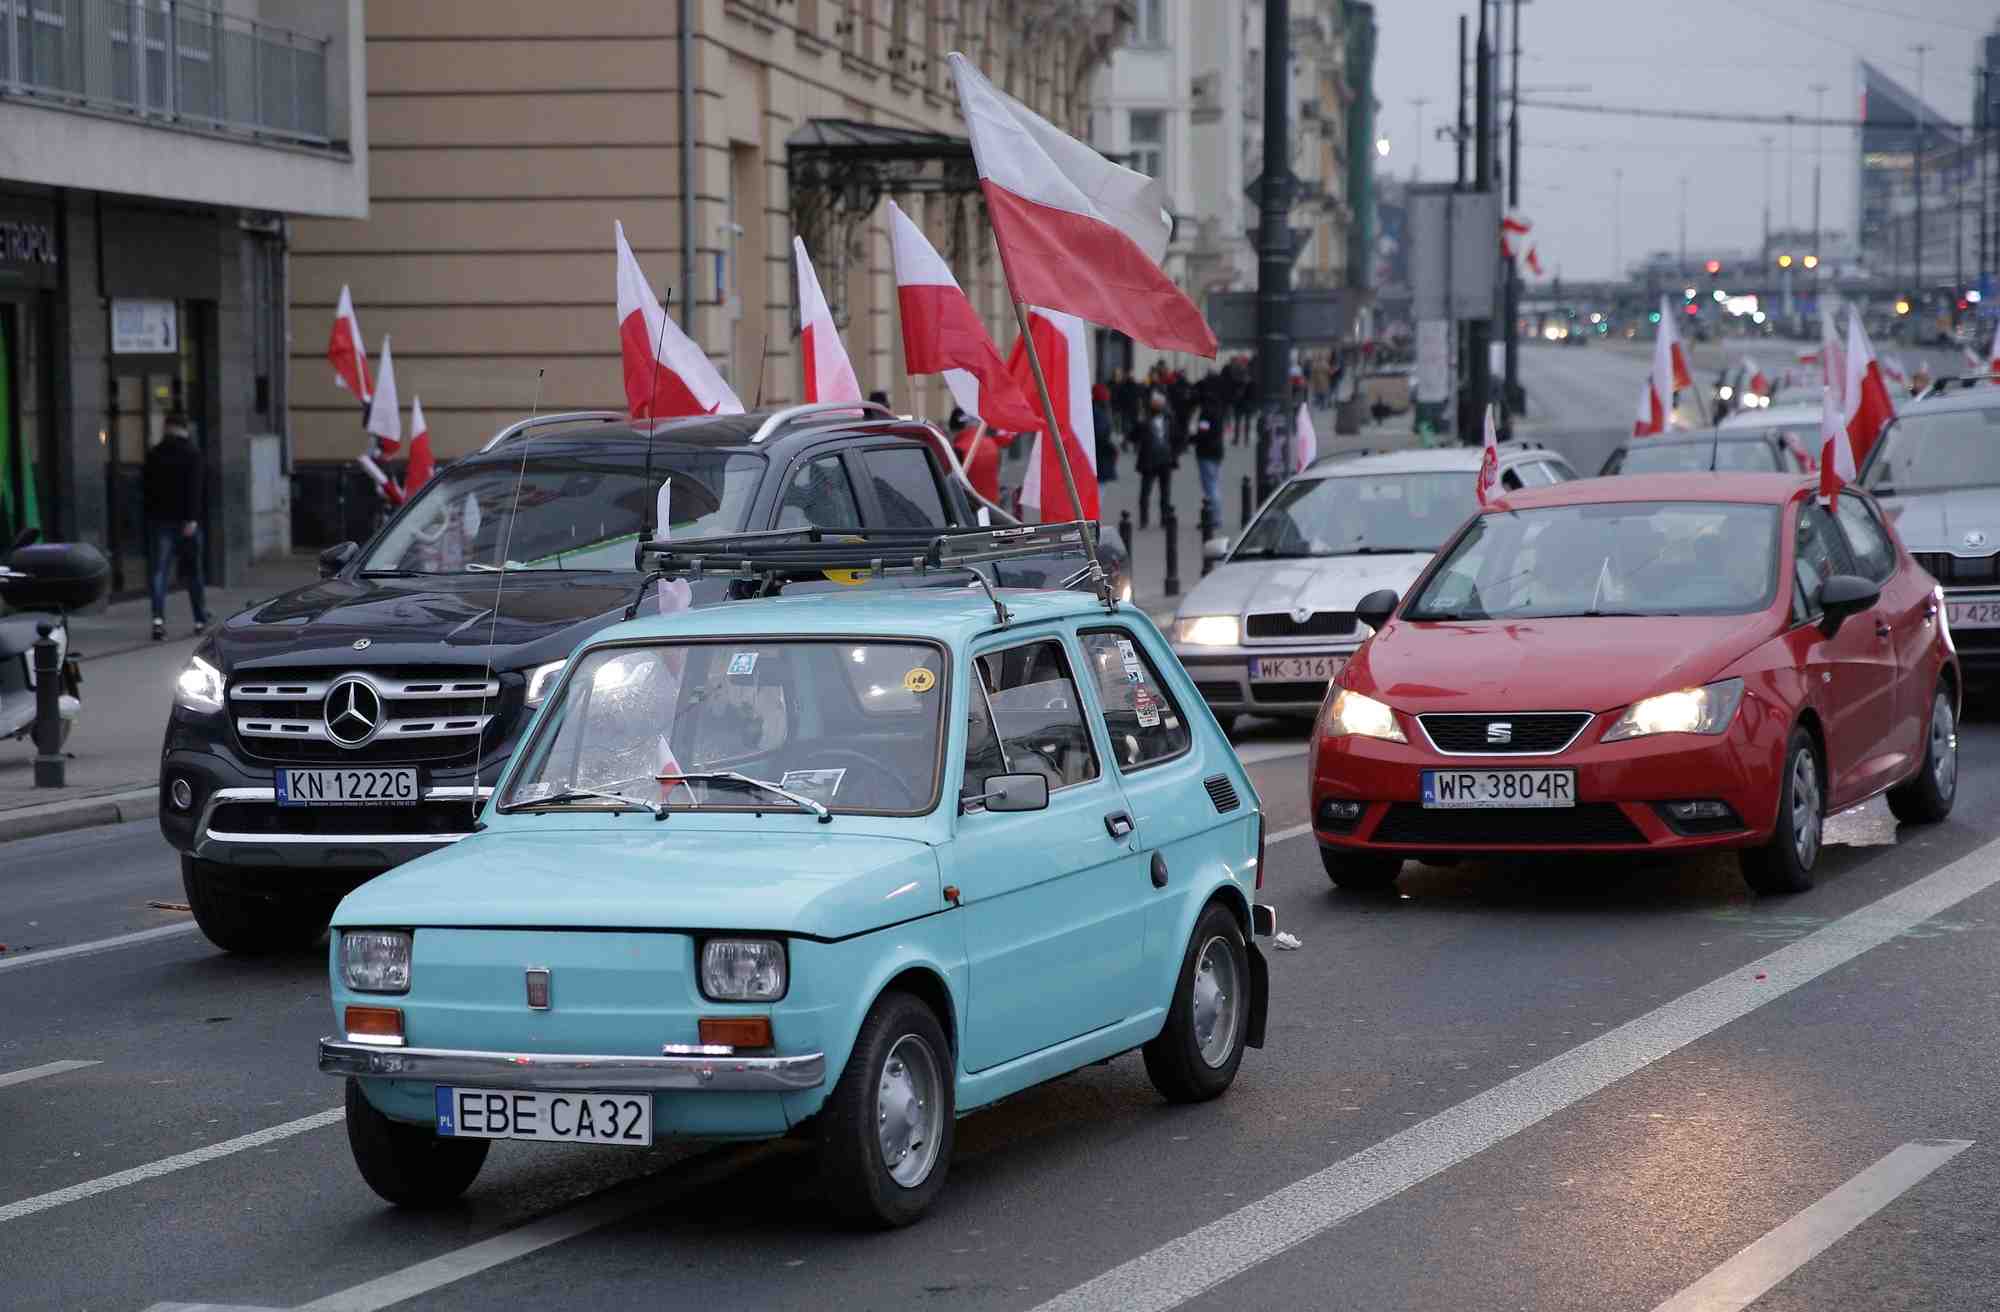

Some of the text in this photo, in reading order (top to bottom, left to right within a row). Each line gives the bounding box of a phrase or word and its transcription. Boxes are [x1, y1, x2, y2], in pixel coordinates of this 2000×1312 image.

[1262, 660, 1286, 678] WK
[292, 772, 411, 799] KN 1222G
[1439, 774, 1570, 799] WR 3804R
[440, 1115, 453, 1127] PL
[459, 1093, 643, 1140] EBE CA32
